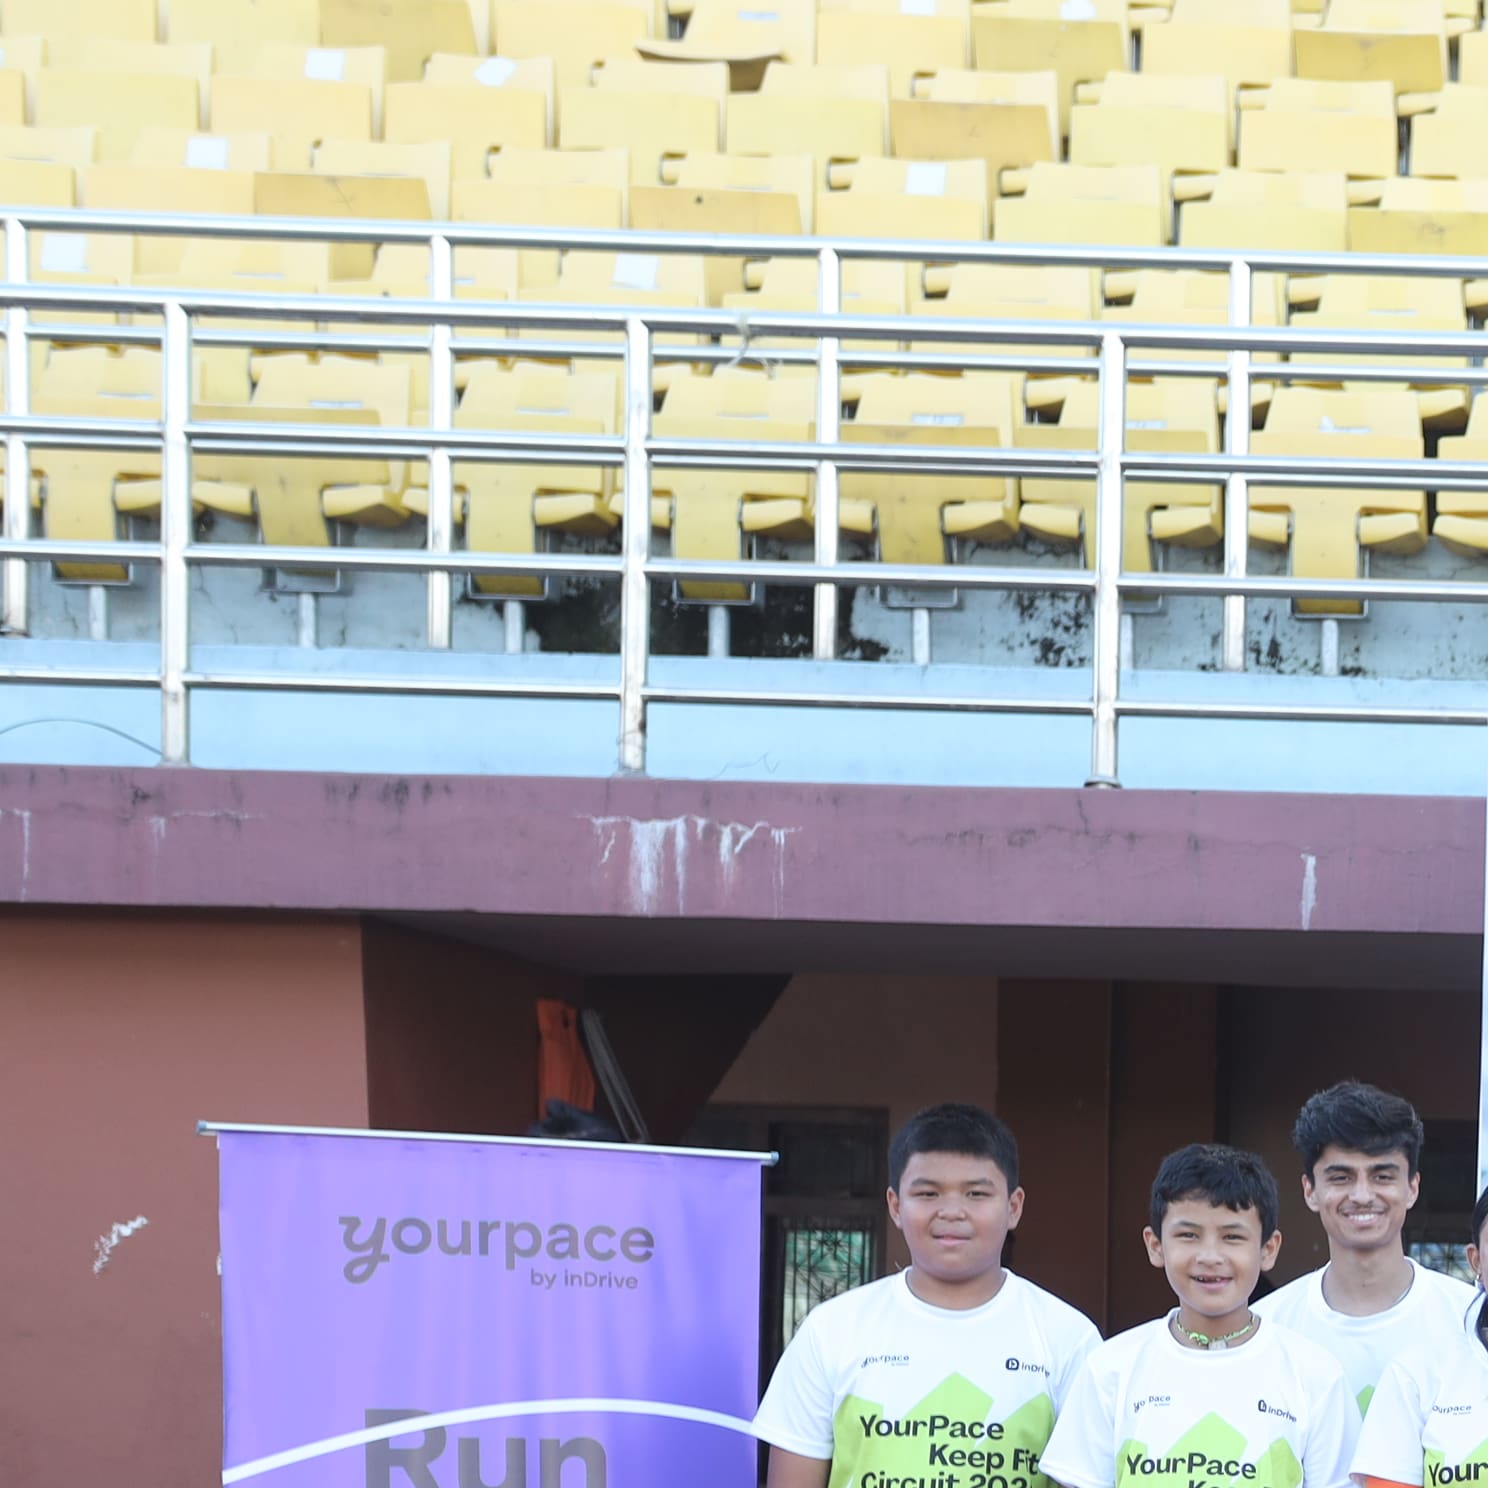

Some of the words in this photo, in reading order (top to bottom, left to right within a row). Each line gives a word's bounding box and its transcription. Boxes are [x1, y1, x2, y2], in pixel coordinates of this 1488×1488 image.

[338, 1215, 655, 1283] yourpace
[530, 1268, 556, 1289] by
[564, 1269, 638, 1290] inDrive
[860, 1414, 1004, 1439] YourPace
[929, 1444, 1004, 1475] Keep
[1012, 1448, 1038, 1476] Fit
[1127, 1452, 1256, 1479] YourPace
